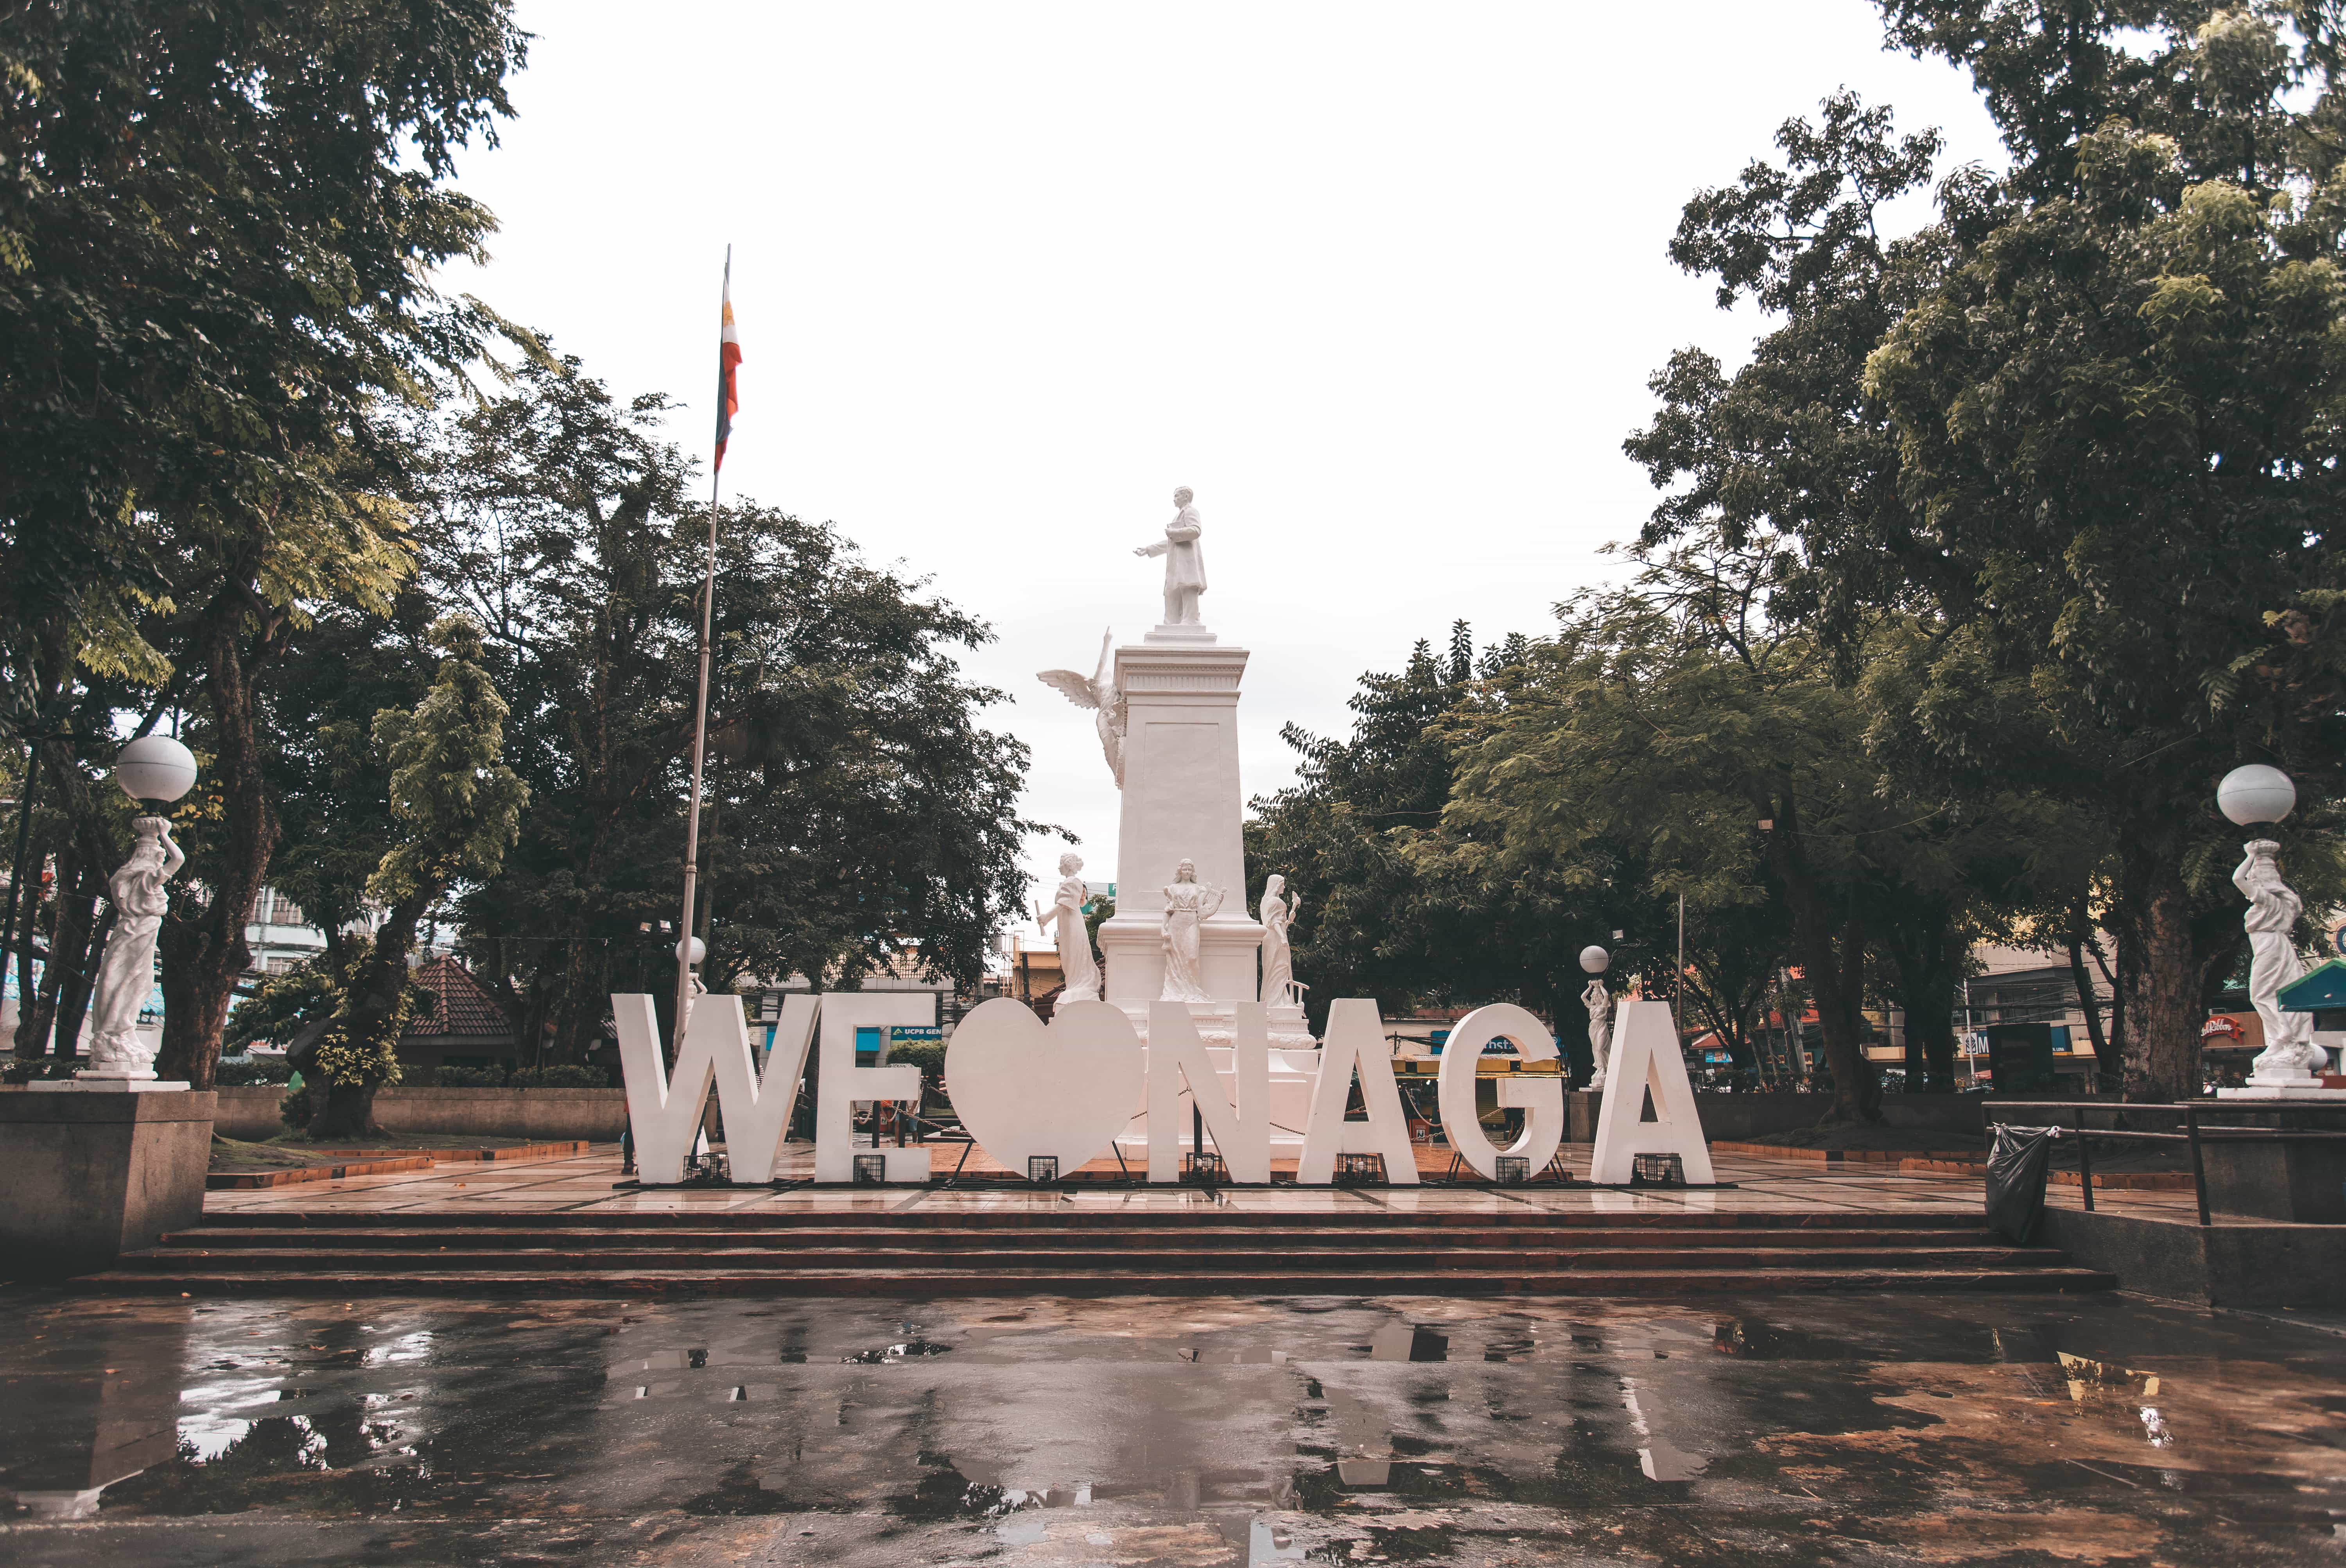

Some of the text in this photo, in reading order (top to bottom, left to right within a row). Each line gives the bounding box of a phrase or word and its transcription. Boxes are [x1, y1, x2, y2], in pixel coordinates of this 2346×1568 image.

[2209, 1019, 2233, 1033] Ribbon
[611, 992, 1716, 1184] WE NAGA
